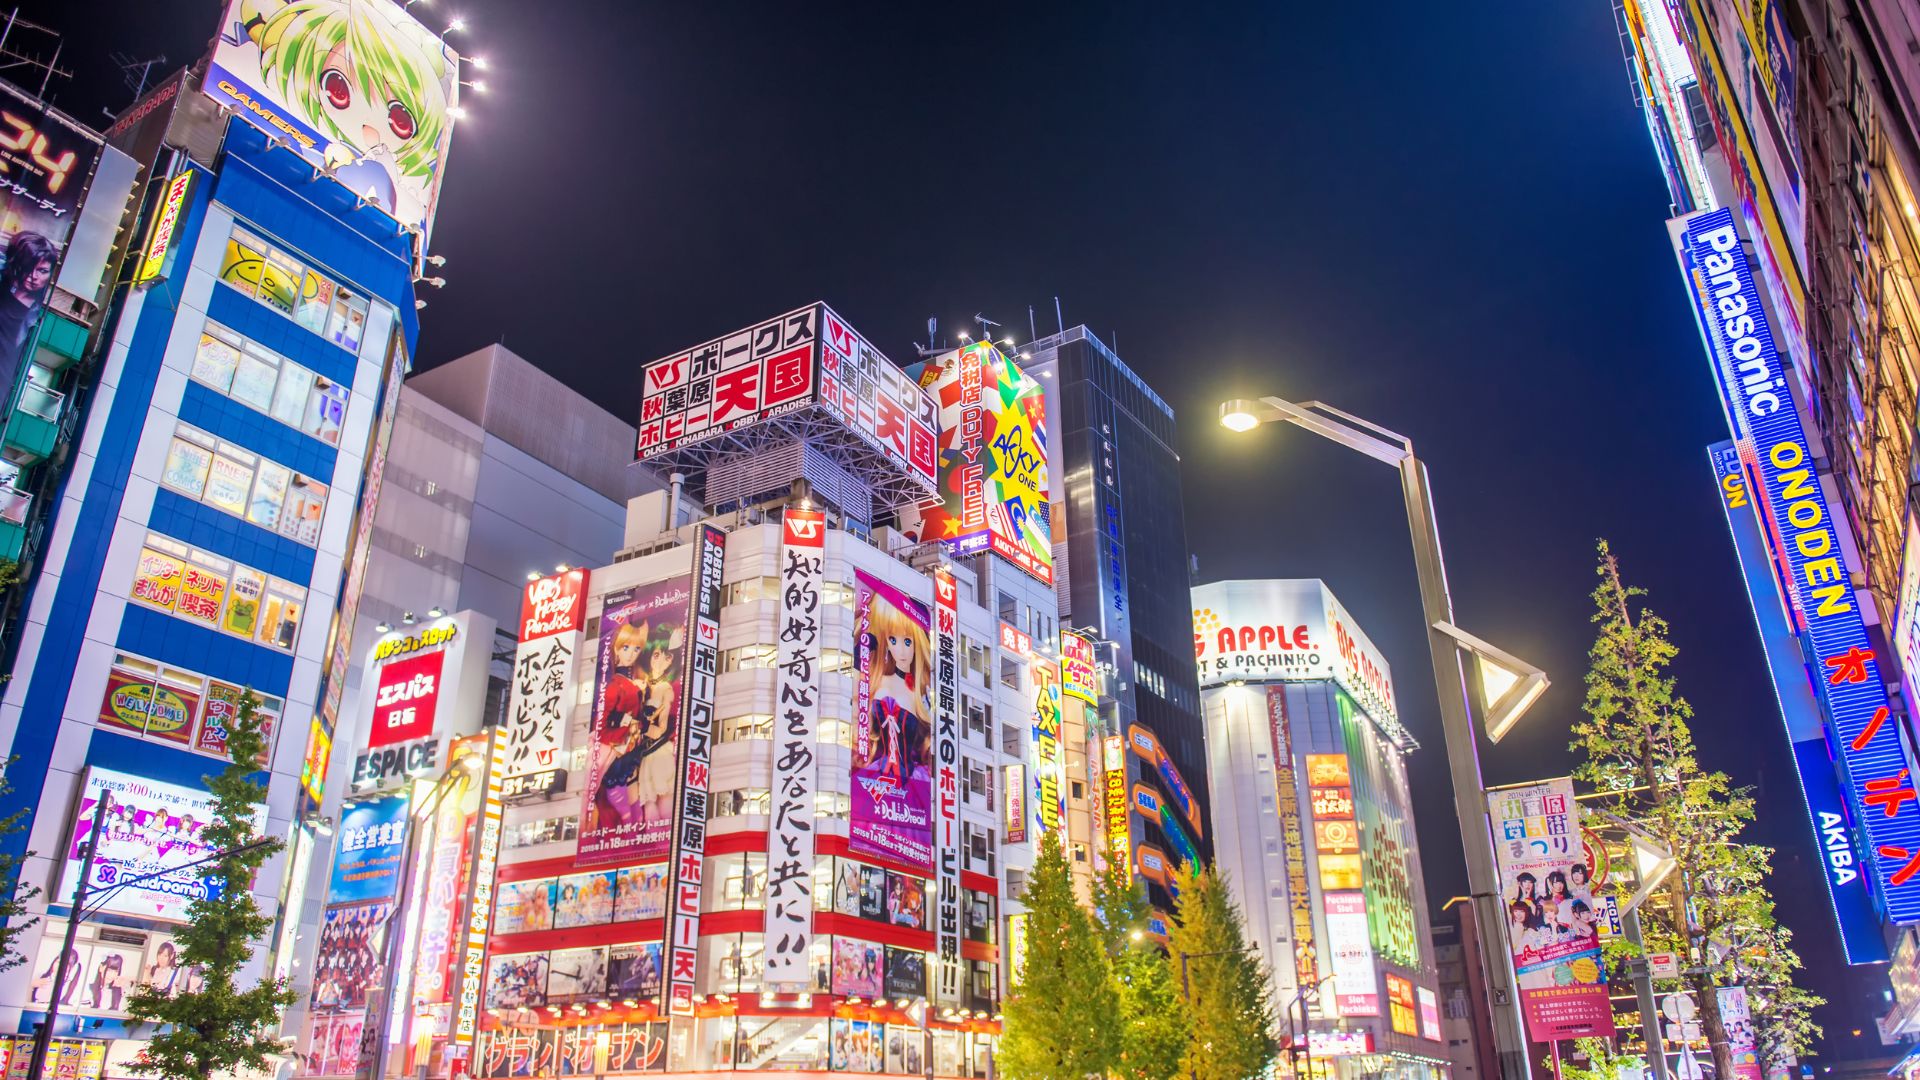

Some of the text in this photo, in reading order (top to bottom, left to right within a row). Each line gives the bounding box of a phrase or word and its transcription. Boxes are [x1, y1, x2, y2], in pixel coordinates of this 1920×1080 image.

[217, 79, 318, 150] GAMERS
[692, 308, 815, 375] ボークス
[1697, 224, 1781, 418] Panasonic
[712, 344, 815, 424] 天国
[822, 343, 875, 406] 秋葉原
[859, 345, 937, 431] ボークス
[642, 381, 713, 423] 秋葉原
[668, 425, 724, 451] AKIHABARA
[725, 413, 760, 432] HOBBY
[761, 396, 813, 420] PARADISE
[821, 374, 874, 426] ホビー
[639, 411, 710, 451] ホビー
[875, 392, 938, 479] 天国
[960, 406, 984, 464] DUTY
[962, 465, 985, 529] FREE
[1017, 472, 1038, 493] ONE
[1768, 440, 1853, 619] ONODEN
[700, 528, 714, 616] PARADISE
[712, 533, 726, 591] HOBBY
[133, 576, 220, 622] まんが喫茶
[1787, 583, 1801, 611] Store
[1003, 626, 1030, 654] 免税
[1216, 653, 1321, 670] & PACHINKO
[1336, 620, 1359, 674] BIG
[115, 693, 185, 723] WELCOME
[376, 673, 435, 708] エスパス
[352, 740, 439, 785] ESPACE
[767, 548, 823, 968] 知的好奇心をあなたと共に!!
[1035, 665, 1059, 829] TAX FREE
[1825, 646, 1920, 886] オノデン
[1138, 791, 1158, 812] SEGA
[1500, 794, 1566, 820] 秋葉原
[1507, 787, 1551, 800] 2014 WINTER
[1503, 814, 1569, 840] 電気街
[1509, 836, 1568, 859] まつり
[1818, 810, 1859, 887] AKIBA
[121, 871, 208, 899] maidreamin
[1325, 895, 1363, 905] Pachinko
[1336, 904, 1354, 913] Slot
[1339, 1005, 1377, 1014] Pachinko
[1348, 995, 1365, 1005] Slot
[485, 1027, 665, 1075] グランドオプン
